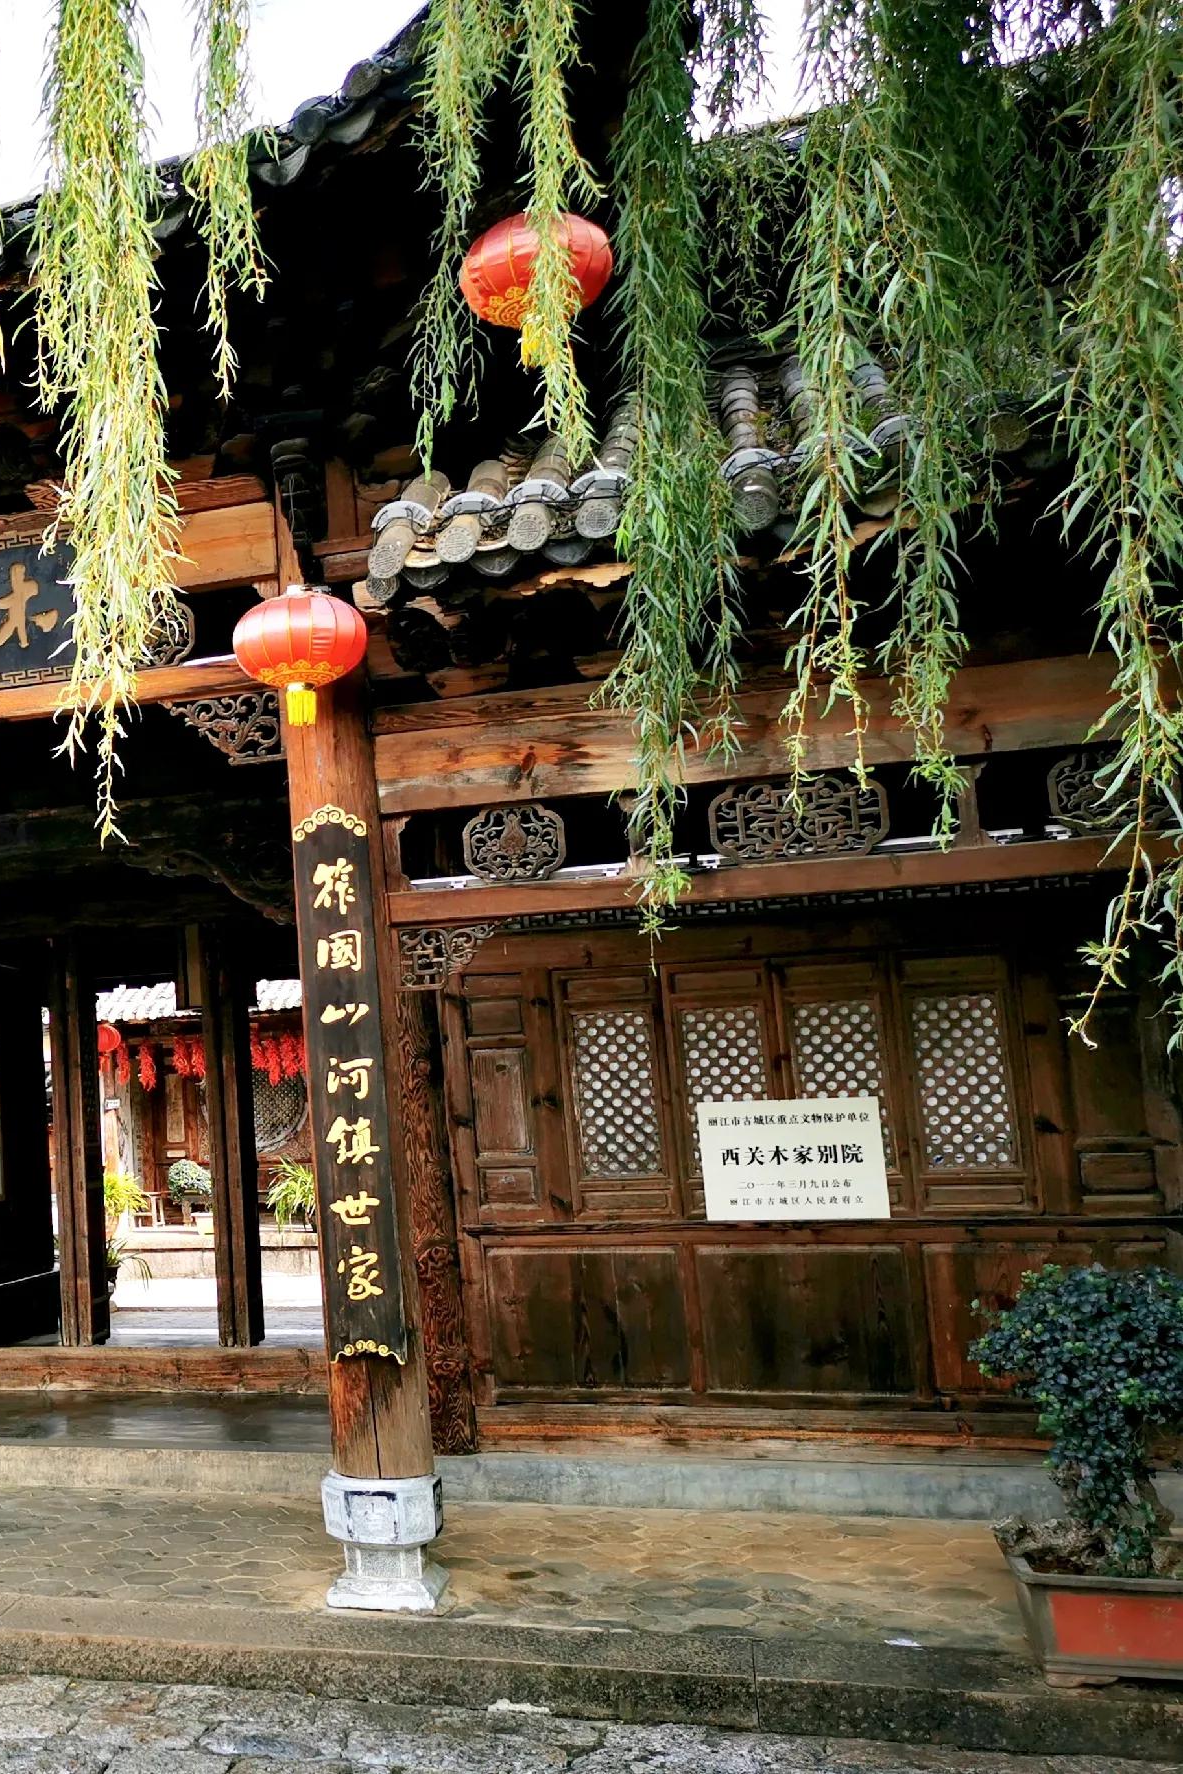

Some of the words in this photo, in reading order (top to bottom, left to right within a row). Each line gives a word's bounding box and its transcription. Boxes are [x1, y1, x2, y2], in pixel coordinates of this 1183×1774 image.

[708, 1112, 870, 1127] 丽江市古城区重点文物保护单位
[721, 1143, 864, 1167] 西关木家别院
[730, 1195, 864, 1206] 丽江市古城区人民政府立
